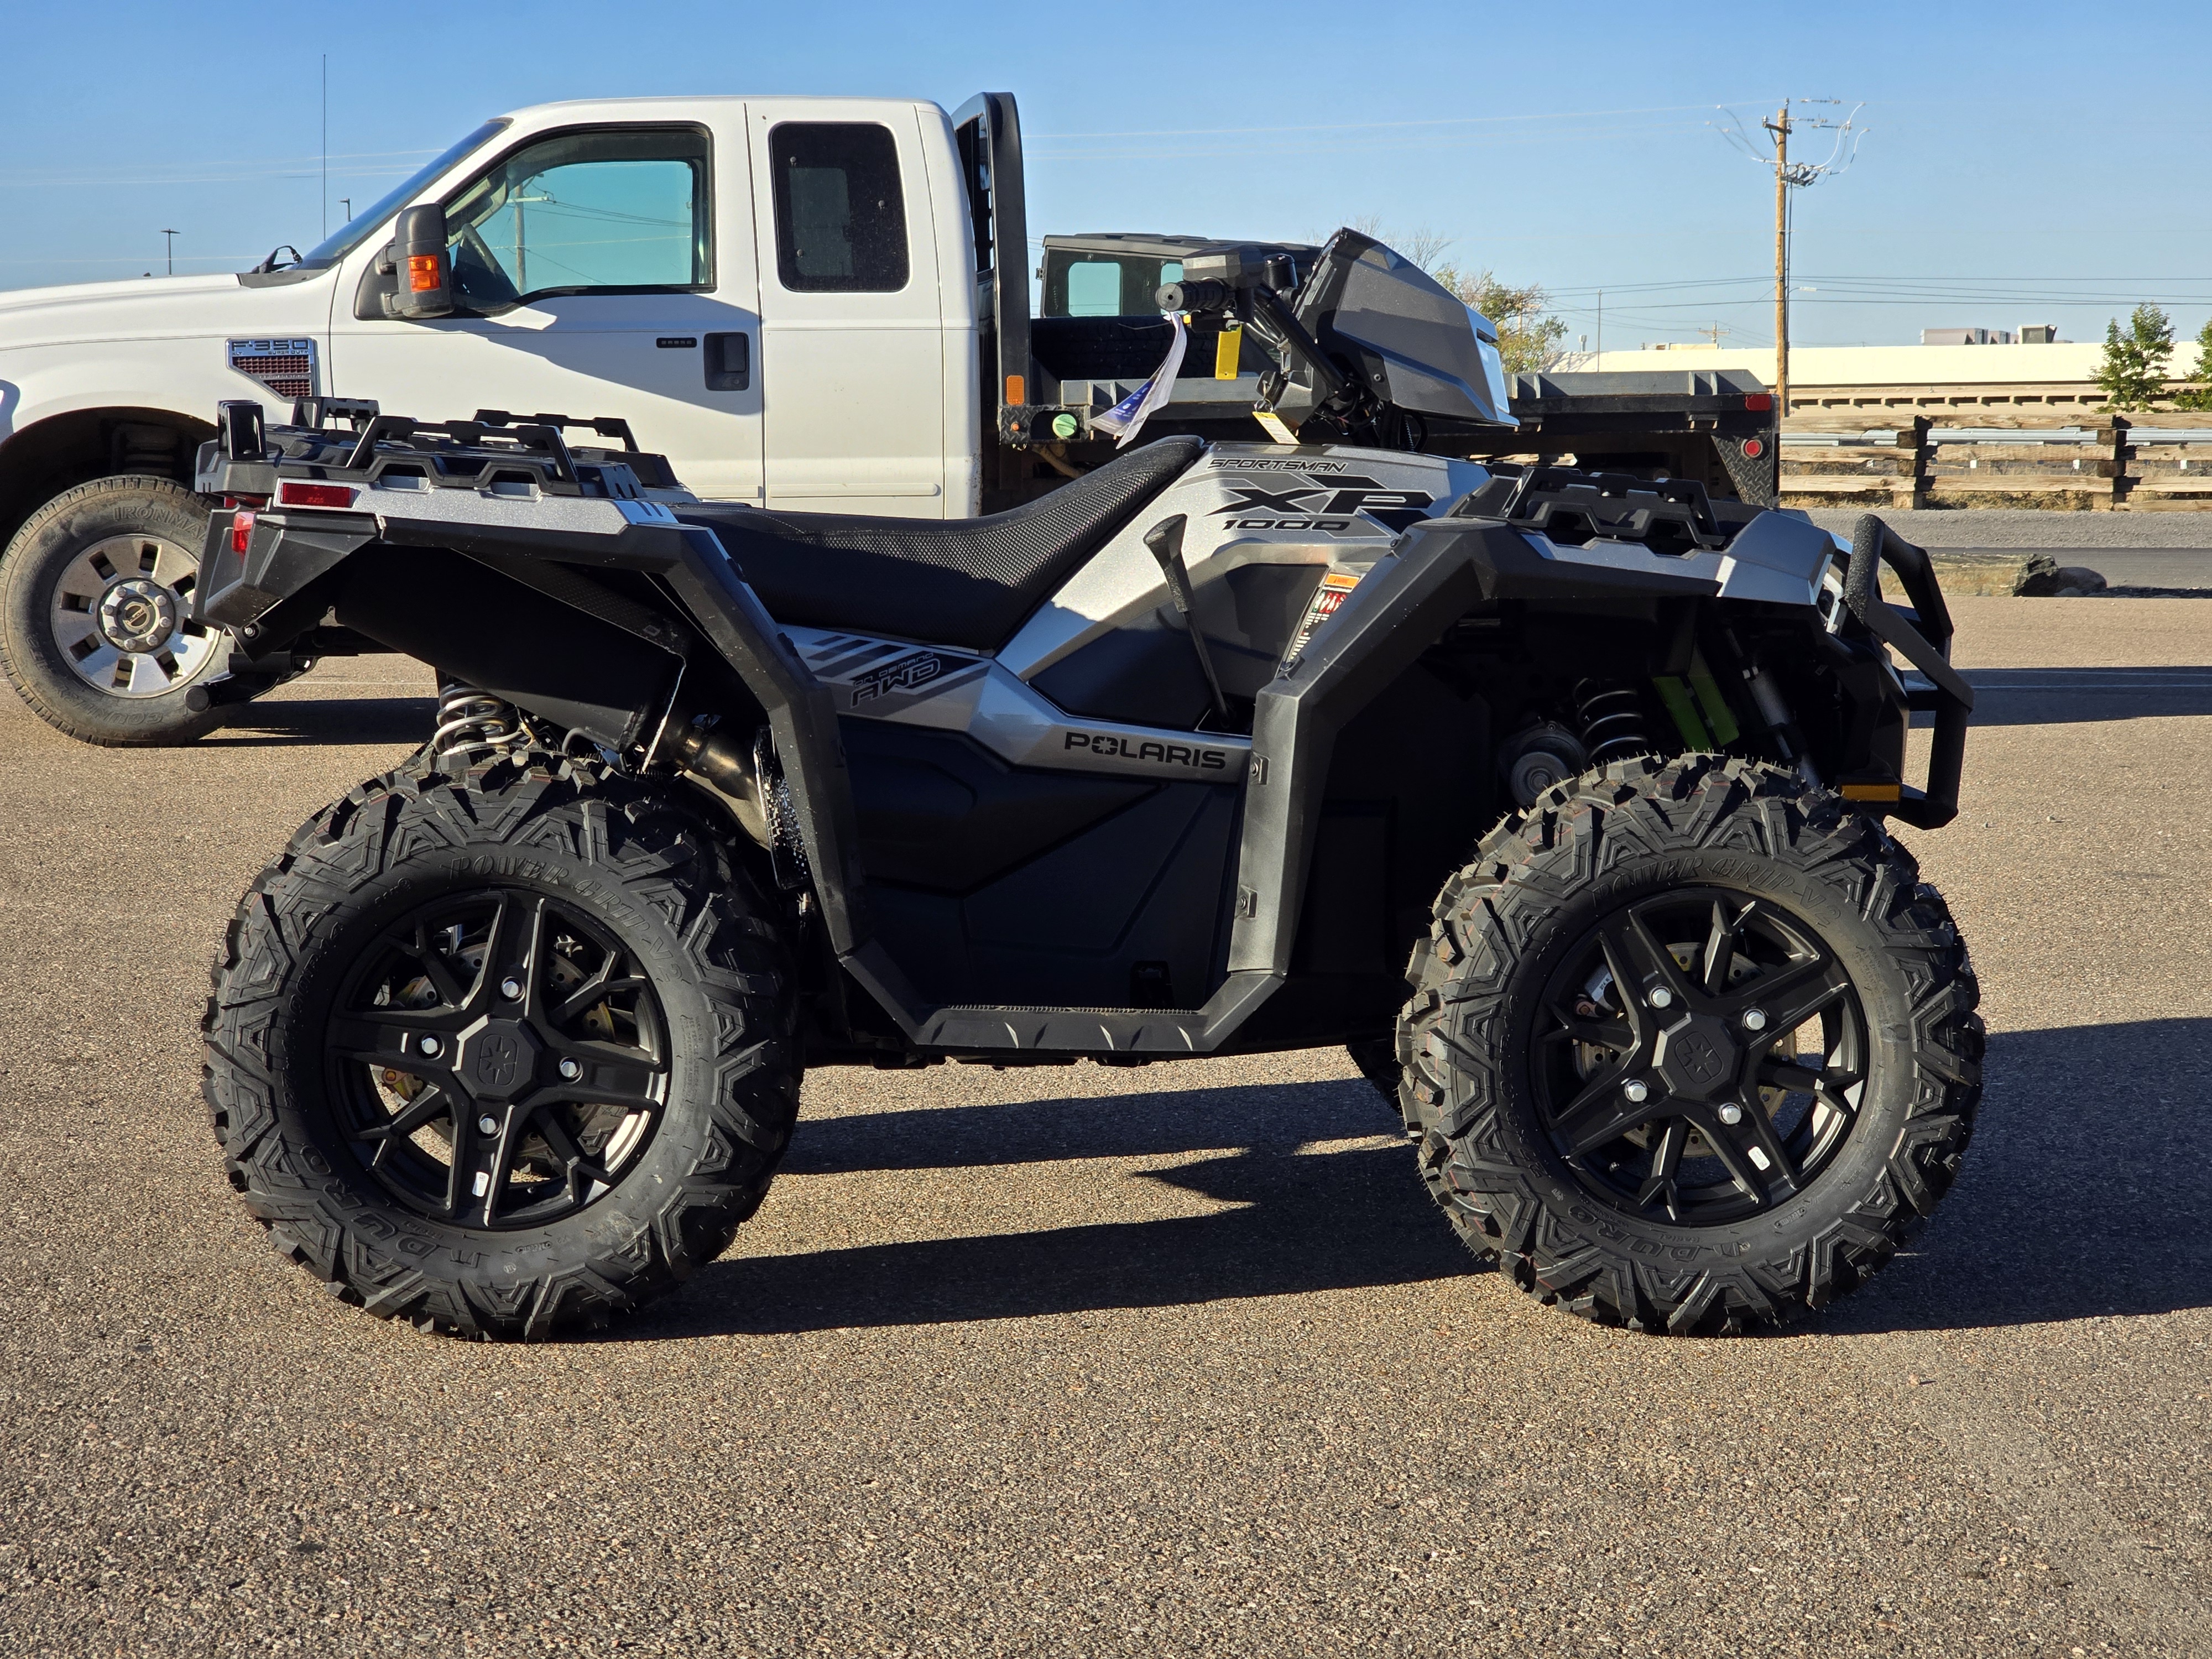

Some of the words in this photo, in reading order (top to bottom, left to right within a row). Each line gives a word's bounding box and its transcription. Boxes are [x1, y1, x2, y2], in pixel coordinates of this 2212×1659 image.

[231, 339, 309, 352] F-350
[1206, 458, 1347, 473] SPORTSMAN
[1204, 488, 1437, 517] XP
[1222, 519, 1350, 531] 1000
[851, 658, 940, 709] AWD
[854, 676, 873, 687] ON
[879, 653, 933, 677] DEMAND
[1065, 732, 1226, 770] POLARIS
[449, 855, 570, 885] POWER
[574, 875, 651, 936] GRIP
[1589, 857, 1704, 907] POWER
[299, 1142, 440, 1262] DURO
[1566, 1201, 1700, 1262] DURO
